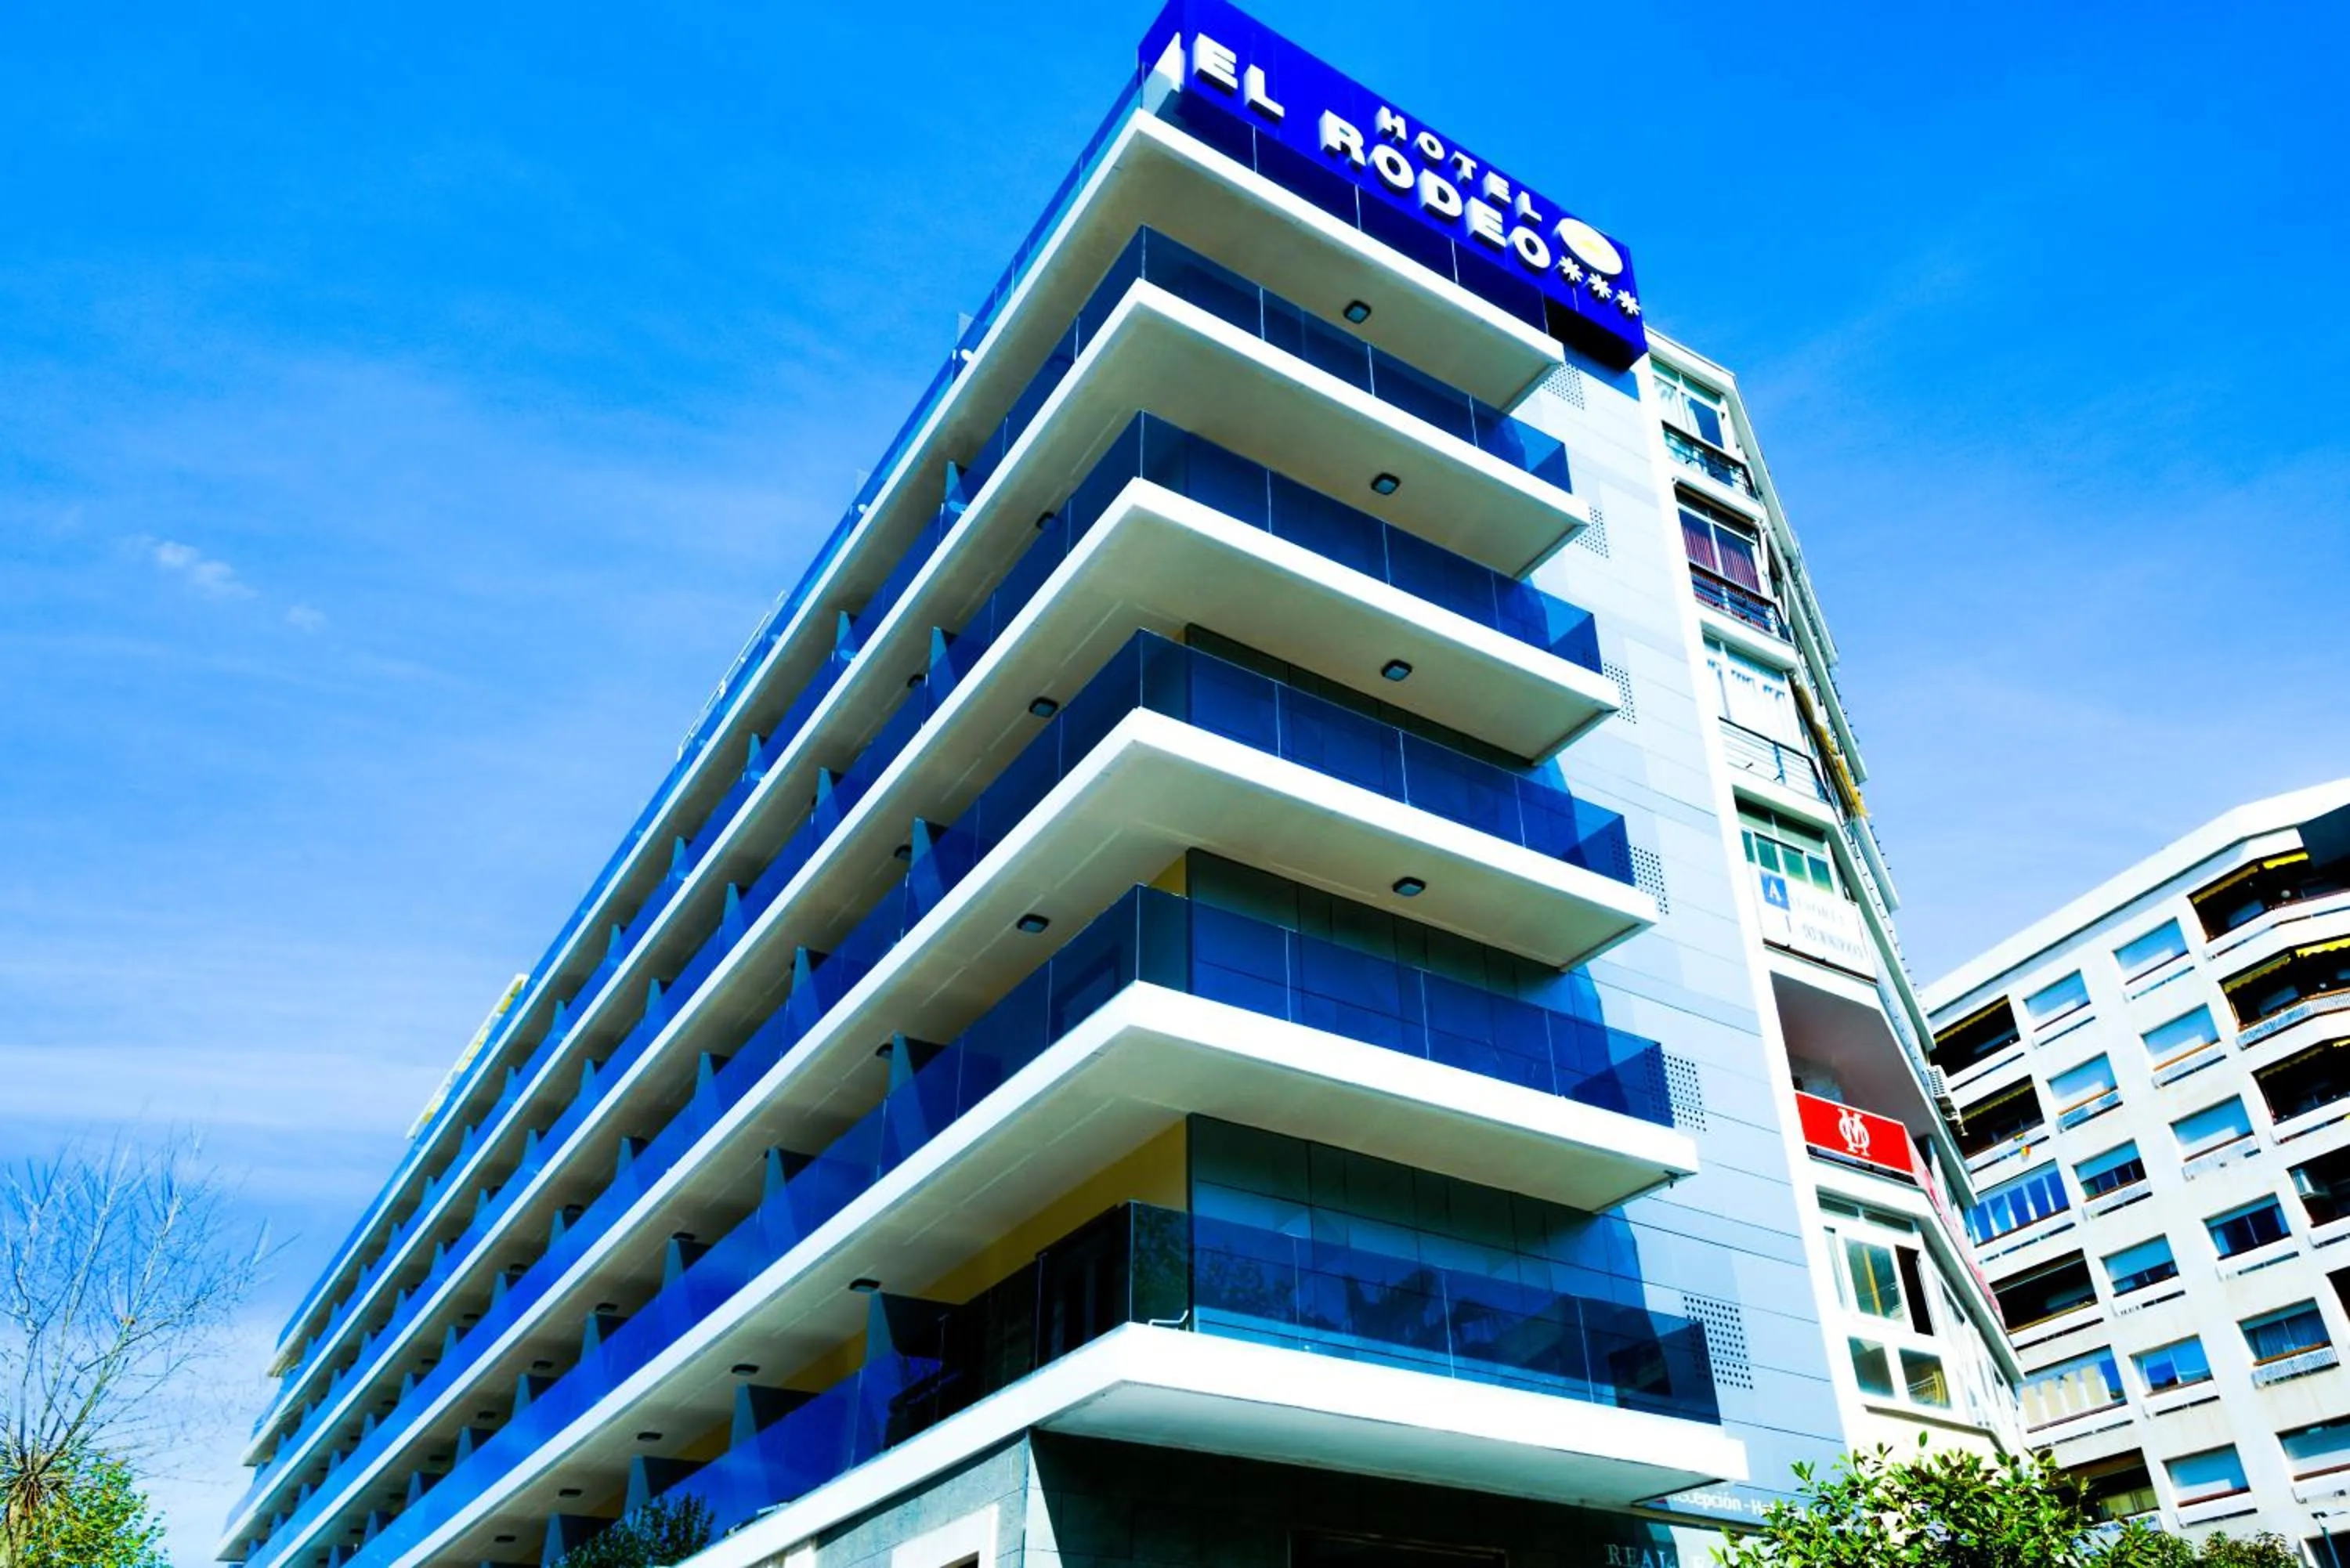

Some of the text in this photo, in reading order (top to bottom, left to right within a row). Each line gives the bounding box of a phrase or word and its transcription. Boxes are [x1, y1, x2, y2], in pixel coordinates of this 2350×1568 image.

[1193, 32, 1284, 117] EL
[1319, 110, 1550, 269] RODEO
[1376, 106, 1542, 225] HOTEL
